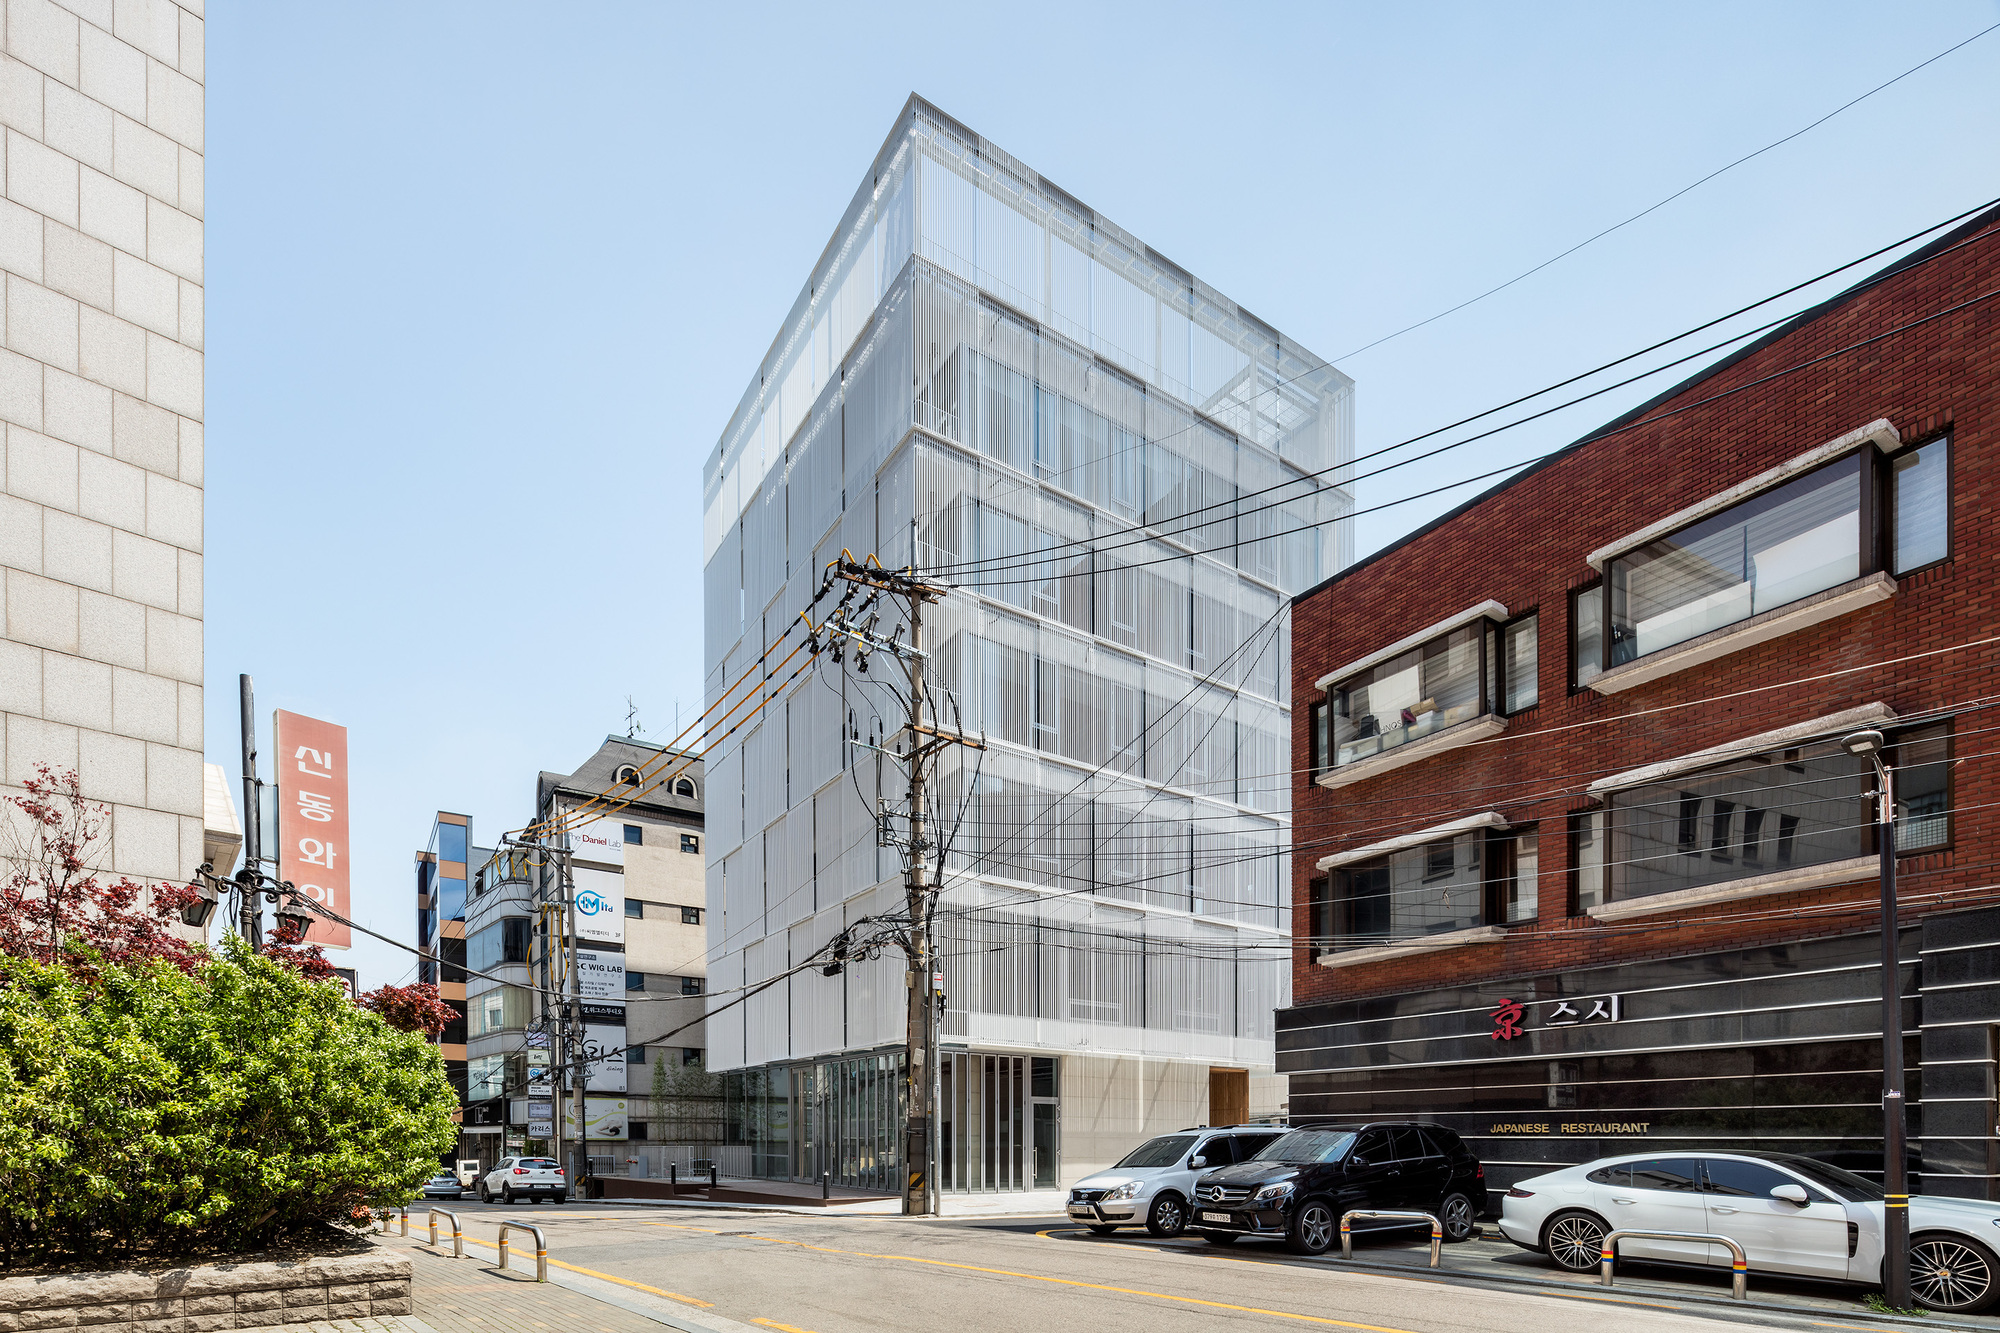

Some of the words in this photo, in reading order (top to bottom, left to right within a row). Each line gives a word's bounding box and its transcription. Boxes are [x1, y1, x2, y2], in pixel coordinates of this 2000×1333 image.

[582, 834, 607, 846] Daniel
[608, 838, 622, 849] Lab
[588, 963, 605, 972] WIG
[607, 965, 623, 974] LAB
[1545, 994, 1618, 1027] 스시
[1490, 1123, 1550, 1134] JAPANESE
[1560, 1122, 1650, 1134] RESTAURANT
